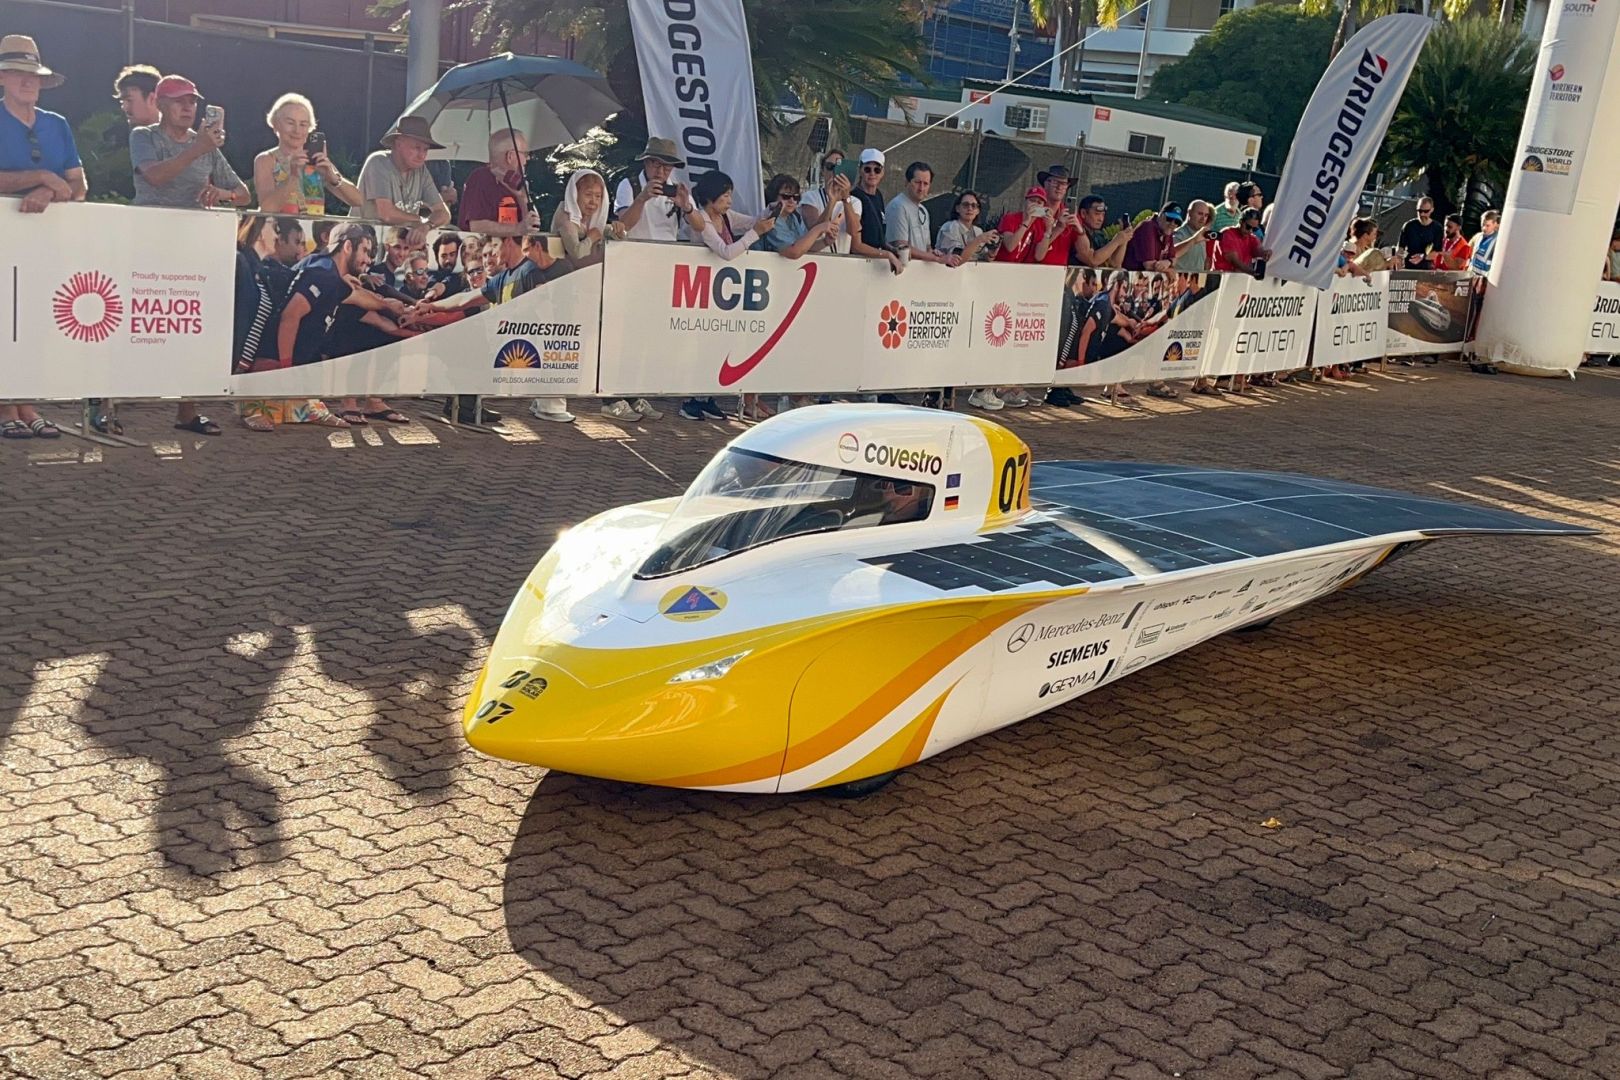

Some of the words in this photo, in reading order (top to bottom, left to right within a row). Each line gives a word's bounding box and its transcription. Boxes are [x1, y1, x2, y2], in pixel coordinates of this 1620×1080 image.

[1563, 4, 1595, 12] SOUTH
[1552, 83, 1582, 92] NORTHERN
[1550, 92, 1580, 102] TERRITORY
[1288, 48, 1388, 268] BRIDGESTONE
[1547, 157, 1572, 165] WORLD
[132, 272, 159, 281] Proudly
[198, 274, 207, 282] by
[168, 288, 200, 297] Territory
[672, 264, 770, 311] MCB
[132, 298, 201, 315] MAJOR
[1235, 294, 1305, 318] BRIDGESTONE
[1331, 292, 1381, 314] BRIDGESTONE
[131, 317, 202, 334] EVENTS
[670, 318, 746, 332] McLAUGHLIN
[750, 320, 766, 333] CB
[910, 312, 959, 324] NORTHERN
[1015, 318, 1045, 329] MAJOR
[496, 321, 582, 336] BRIDGESTONE
[909, 326, 953, 339] TERRITORY
[1014, 331, 1045, 341] EVENTS
[1333, 322, 1377, 346] ENLITEN
[130, 336, 166, 344] Company
[544, 340, 580, 350] WORLD
[907, 340, 949, 349] GOVERNMENT
[1236, 329, 1295, 353] ENLITEN
[543, 352, 579, 362] SOLAR
[865, 443, 942, 475] covestro
[999, 452, 1028, 514] 07
[1034, 613, 1126, 641] Mercedes-Benz
[1047, 640, 1110, 669] SIEMENS
[476, 700, 515, 724] 07
